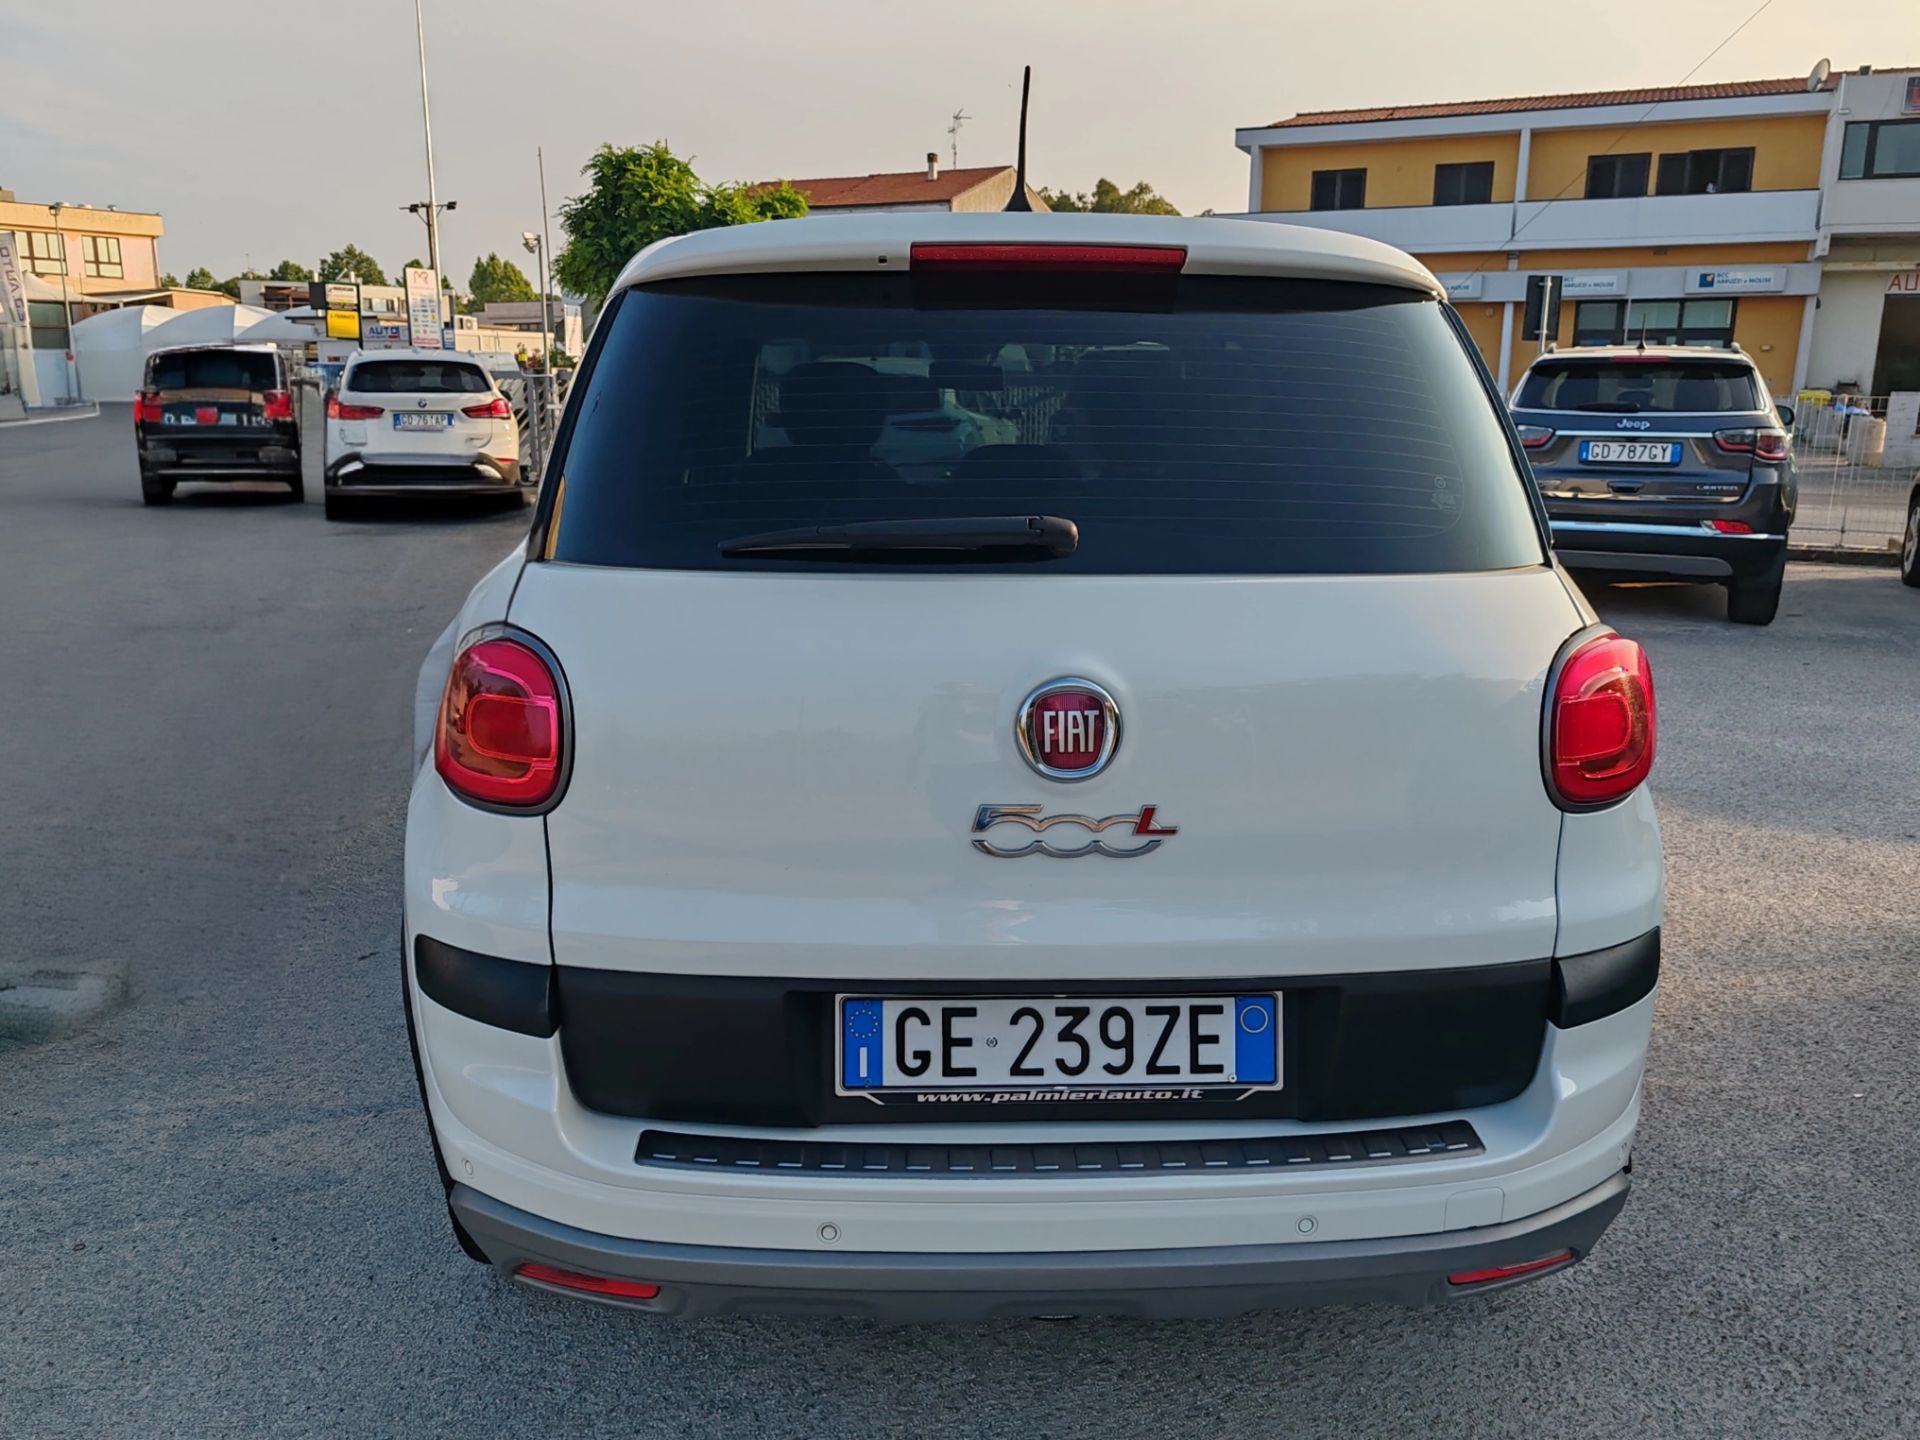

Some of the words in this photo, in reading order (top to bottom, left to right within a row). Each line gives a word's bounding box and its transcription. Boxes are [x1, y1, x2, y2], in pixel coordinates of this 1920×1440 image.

[1617, 418, 1650, 430] Jeep
[1591, 444, 1611, 459] GD
[1616, 444, 1669, 461] 787GY
[1043, 710, 1099, 753] FIAT
[895, 1006, 977, 1077] GE
[1009, 1004, 1224, 1077] 239ZE
[916, 1088, 1204, 1104] www.palmieriauto.it
